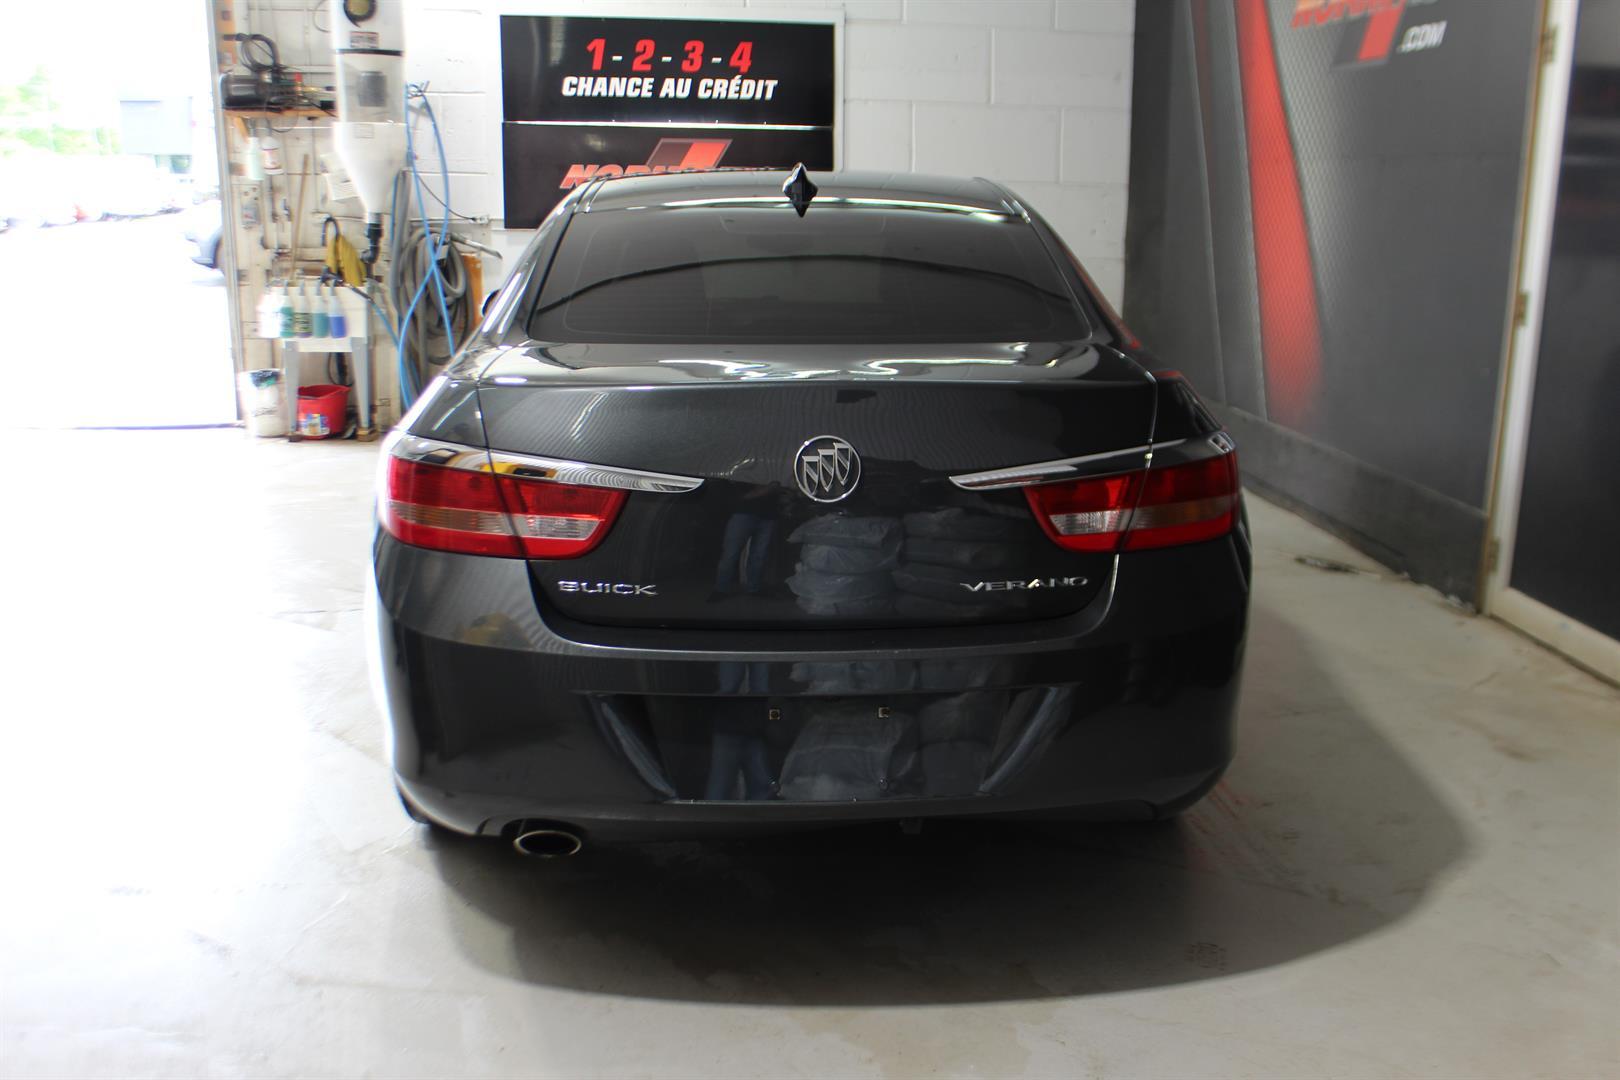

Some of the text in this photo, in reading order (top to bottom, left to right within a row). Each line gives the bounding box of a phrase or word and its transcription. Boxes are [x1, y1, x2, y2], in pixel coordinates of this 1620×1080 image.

[562, 75, 778, 100] CHANCE AU CRÉDIT
[558, 581, 658, 595] BUICK
[960, 577, 1088, 592] VERANO
